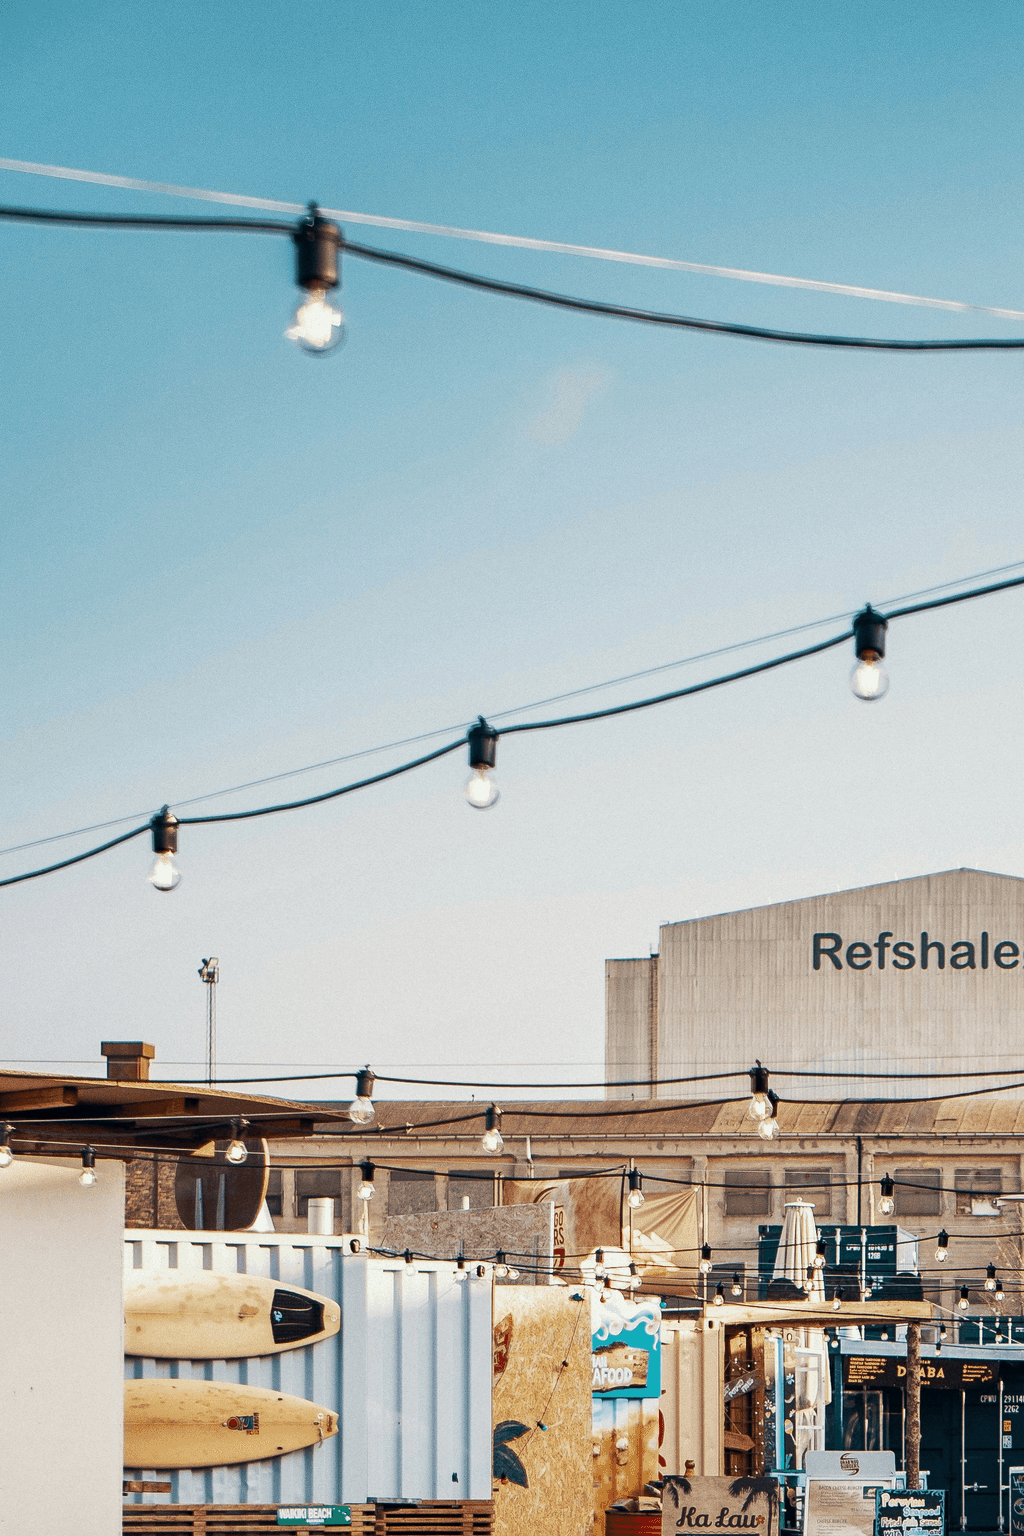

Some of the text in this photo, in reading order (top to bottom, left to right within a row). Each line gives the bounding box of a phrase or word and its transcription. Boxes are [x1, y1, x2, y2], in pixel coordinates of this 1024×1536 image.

[592, 1367, 633, 1385] AFOOD
[897, 1365, 946, 1379] DABA
[279, 1508, 332, 1519] WAIKIKI BEACH
[676, 1507, 758, 1528] Ka Lau
